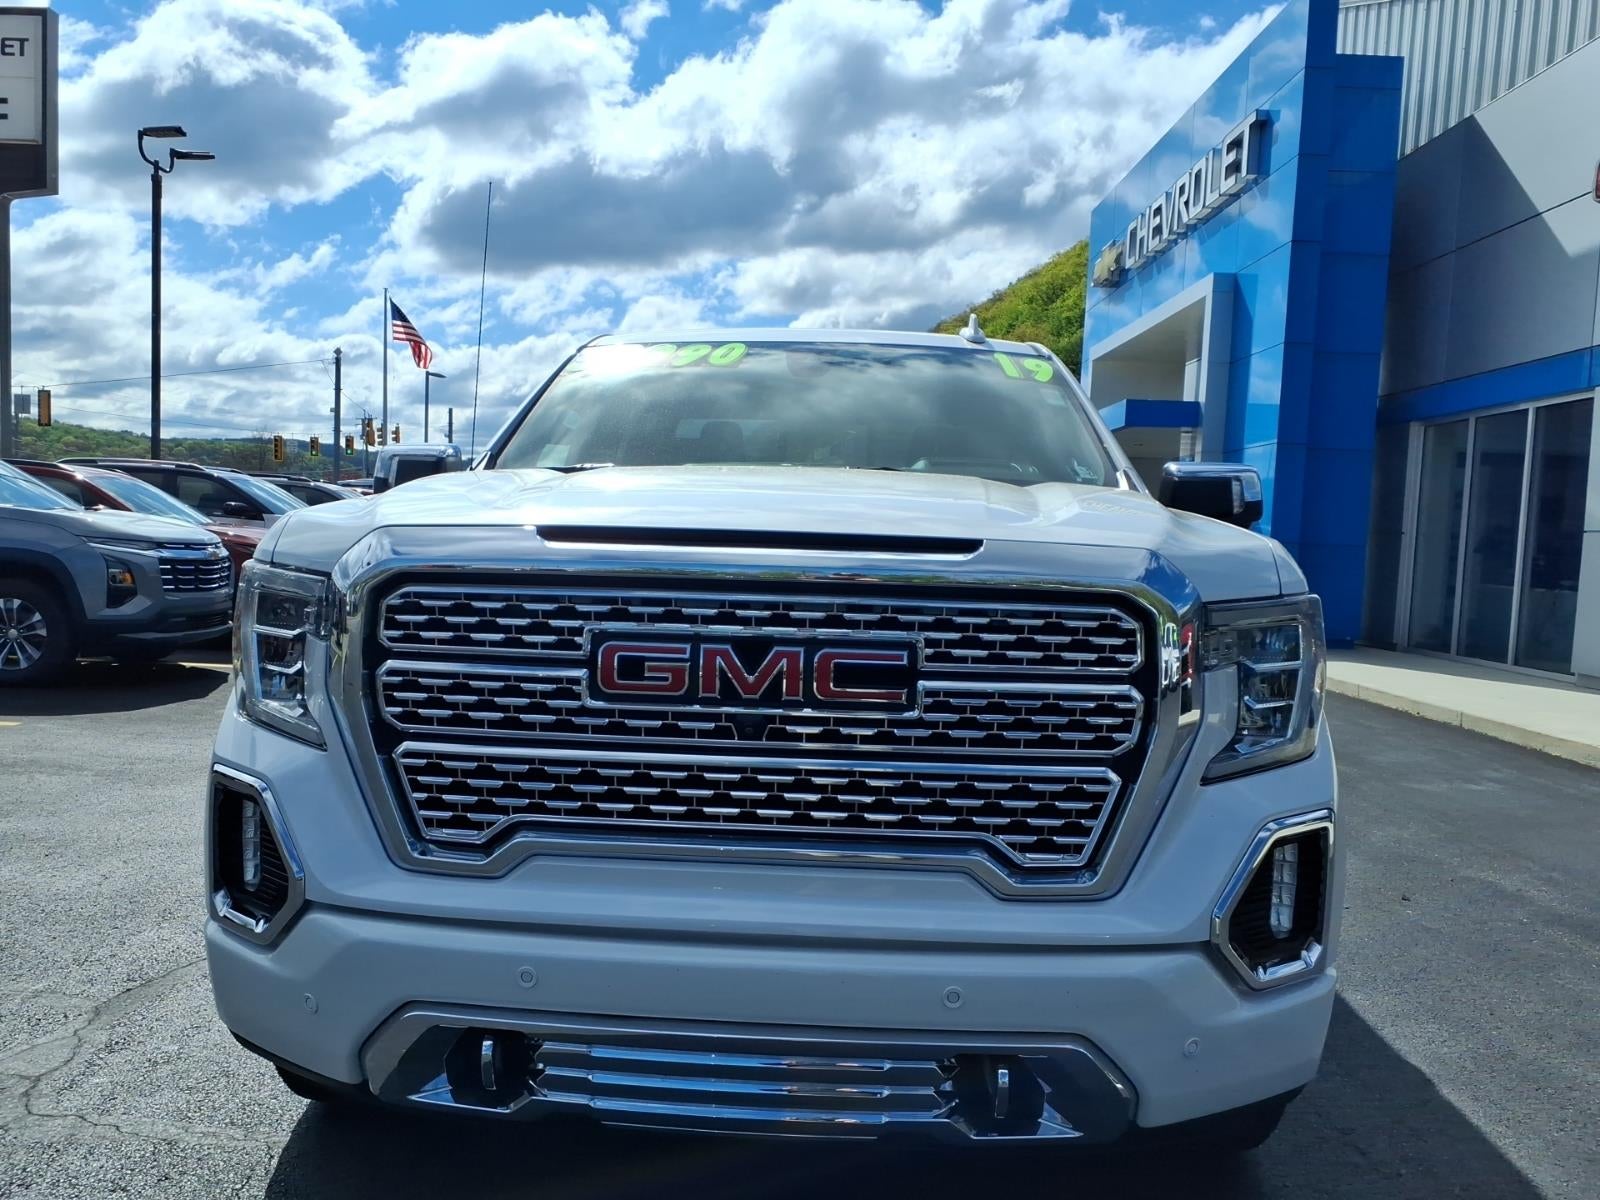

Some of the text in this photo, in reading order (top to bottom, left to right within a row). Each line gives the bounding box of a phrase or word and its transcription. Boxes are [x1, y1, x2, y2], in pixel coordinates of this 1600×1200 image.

[1125, 108, 1262, 270] CHEVROLET
[992, 352, 1053, 383] 19
[598, 641, 908, 704] GMC
